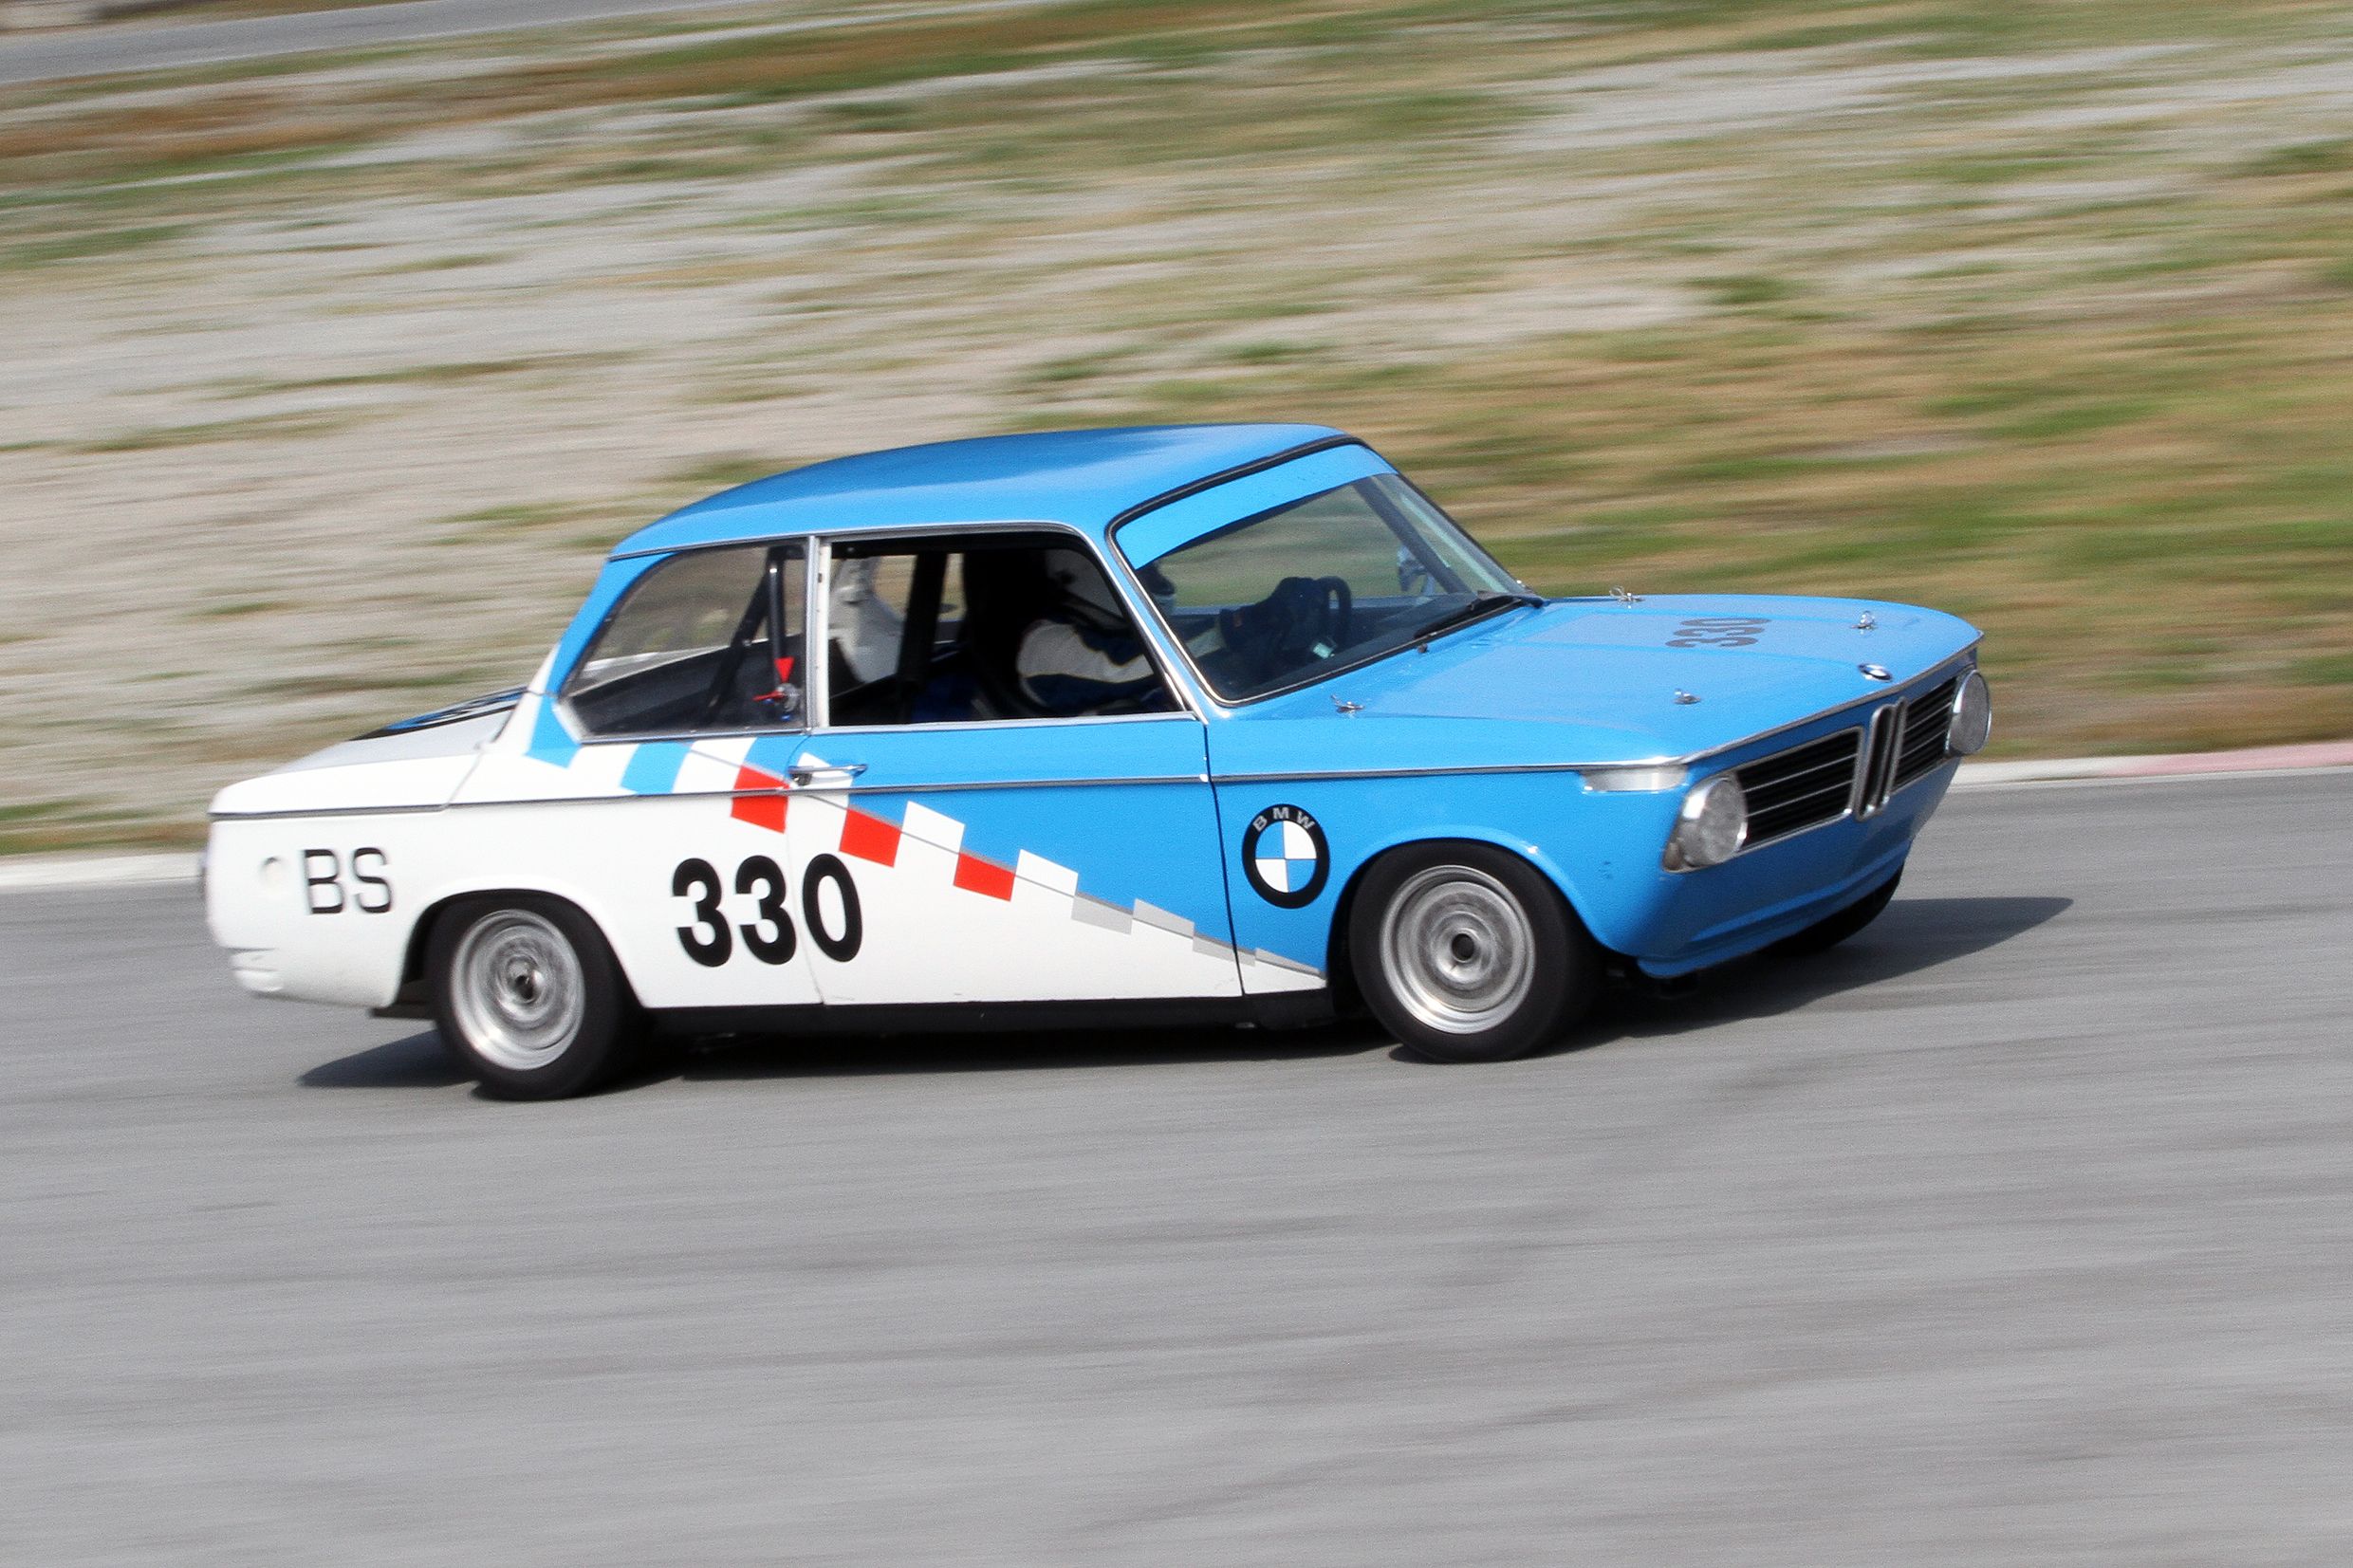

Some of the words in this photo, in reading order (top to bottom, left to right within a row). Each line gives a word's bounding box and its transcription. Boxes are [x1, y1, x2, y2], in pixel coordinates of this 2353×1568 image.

[1665, 618, 1772, 648] 330
[1252, 806, 1316, 832] BMW
[303, 847, 392, 914] BS
[672, 853, 862, 968] 330
